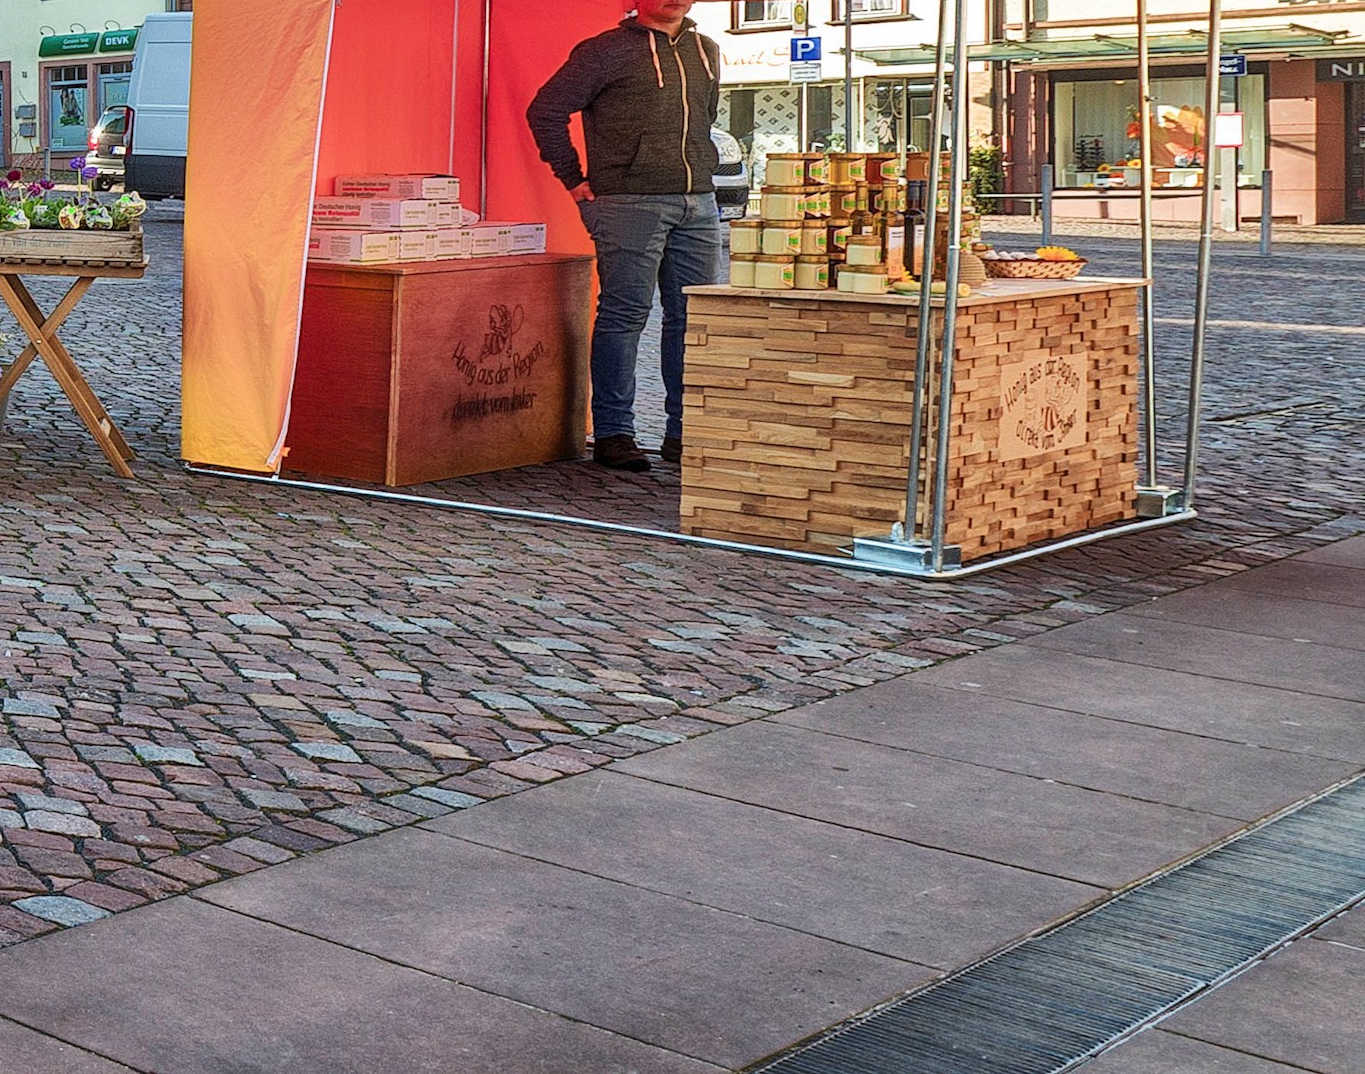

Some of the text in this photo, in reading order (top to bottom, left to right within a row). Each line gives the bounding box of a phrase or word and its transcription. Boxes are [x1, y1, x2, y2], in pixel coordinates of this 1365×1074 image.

[105, 36, 130, 46] DEVK
[796, 39, 815, 60] P
[345, 203, 361, 211] Honig
[452, 340, 544, 386] Honig aus der Region
[1004, 372, 1028, 413] Honig
[1029, 363, 1042, 384] aus
